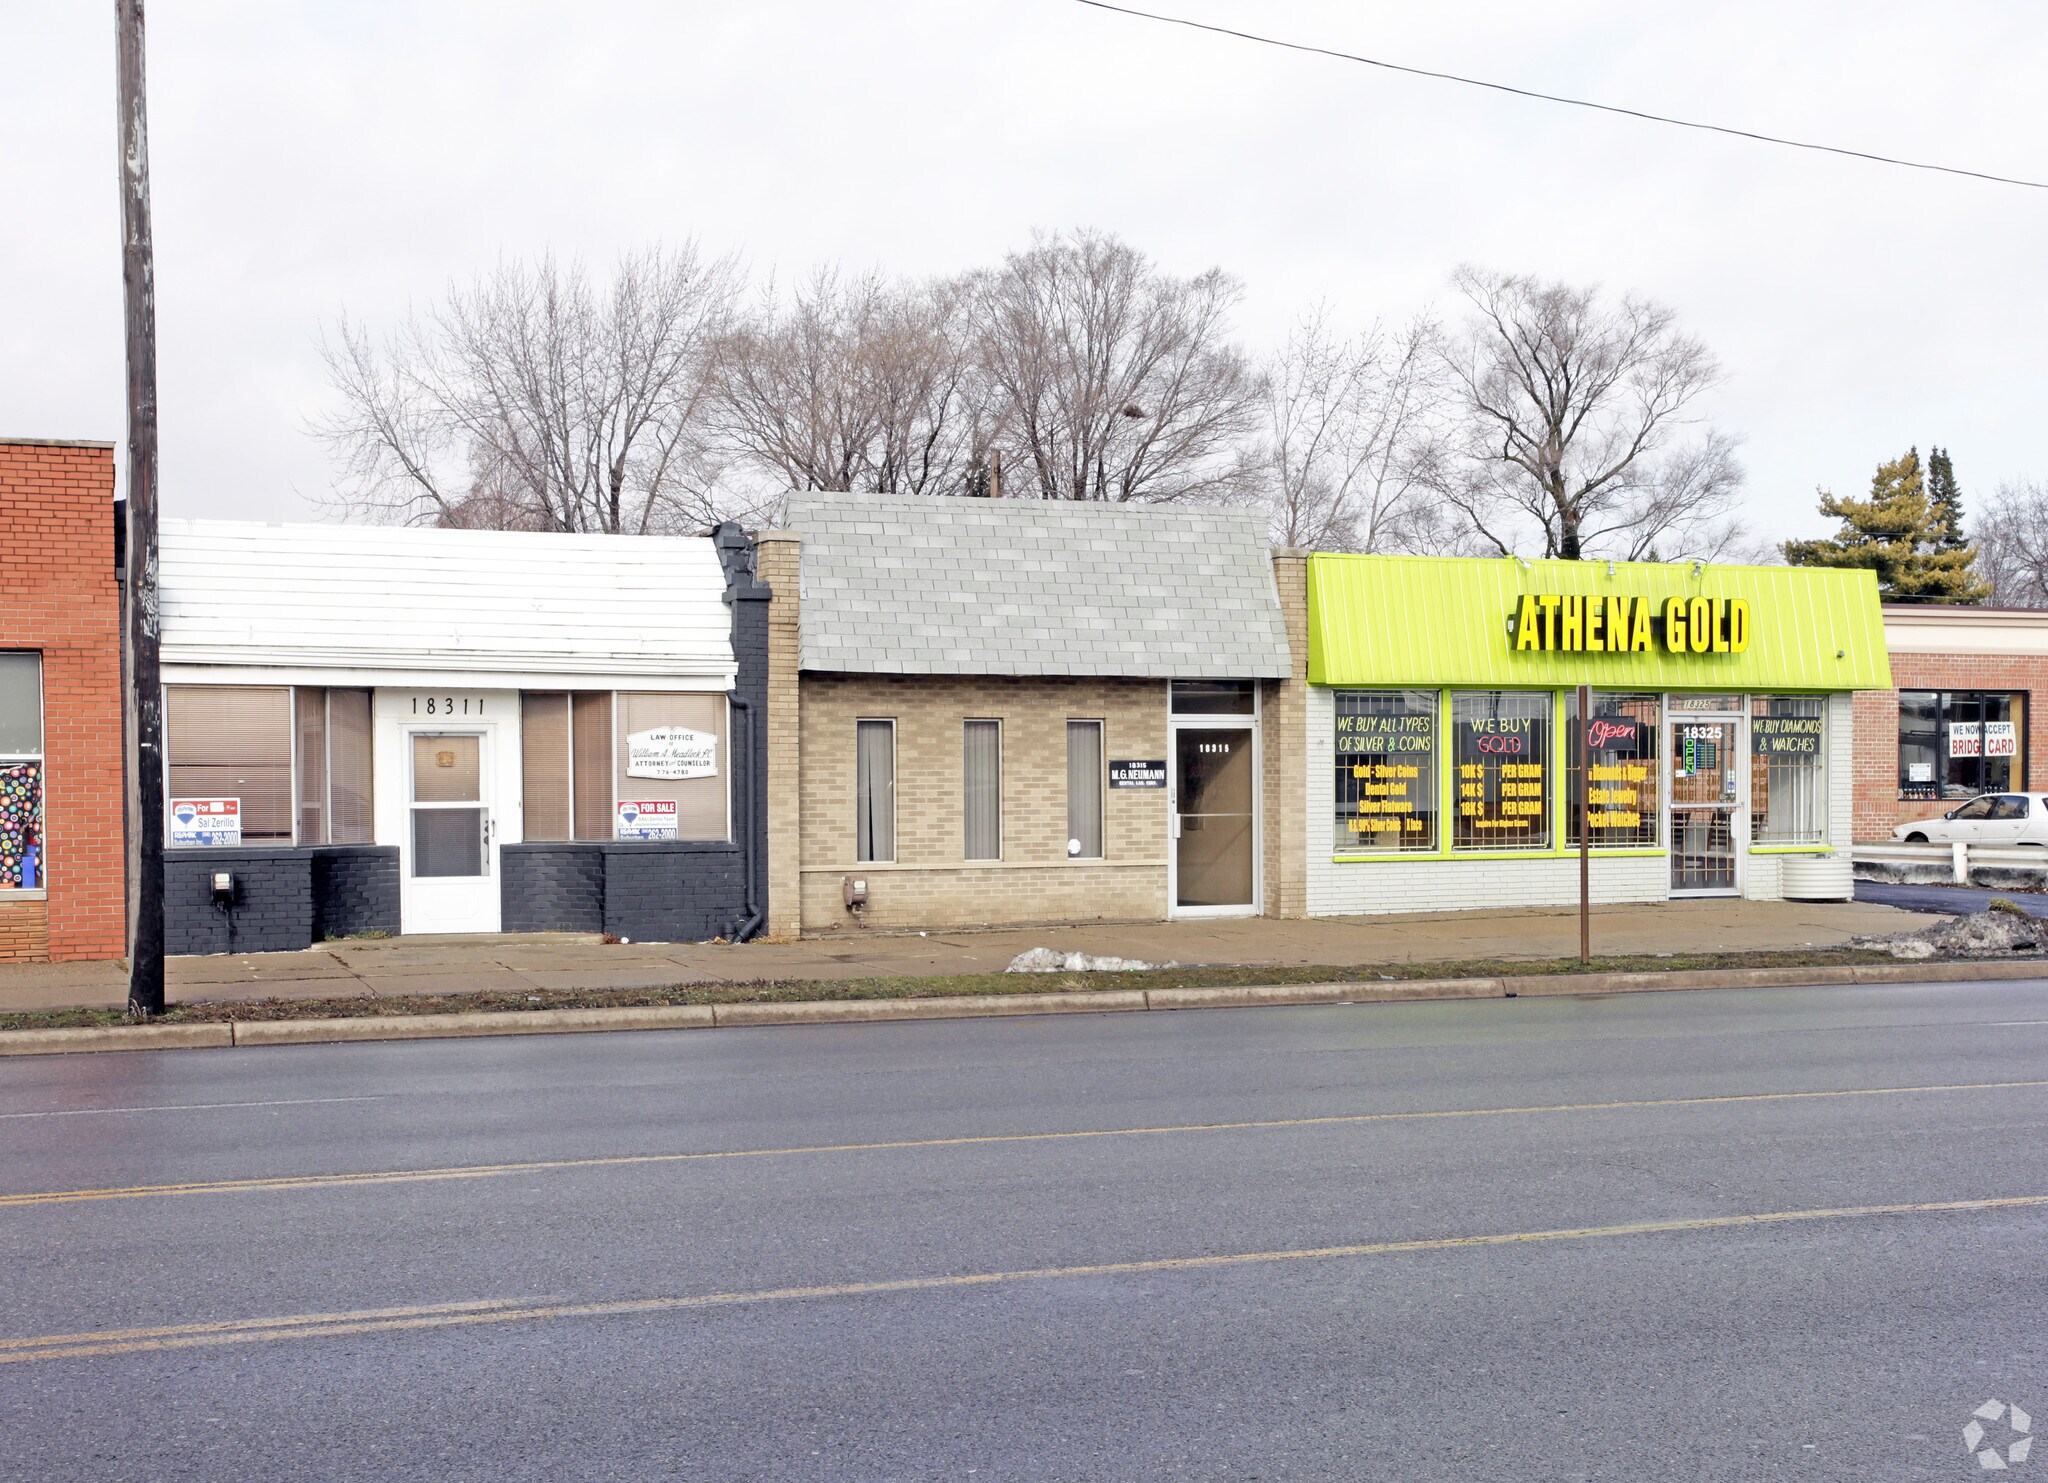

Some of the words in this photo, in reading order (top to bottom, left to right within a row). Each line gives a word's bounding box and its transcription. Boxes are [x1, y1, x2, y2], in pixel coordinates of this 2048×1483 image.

[1516, 594, 1652, 652] ATHENA
[1666, 596, 1750, 653] GOLD
[412, 697, 484, 715] 18311
[1684, 700, 1711, 708] 18325
[1337, 716, 1354, 732] WE
[1355, 716, 1378, 732] BUY
[1379, 718, 1397, 733] ALL
[1399, 716, 1430, 732] TYPES
[1471, 718, 1496, 733] WE
[1499, 718, 1531, 733] BUY
[1753, 719, 1764, 734] WE
[1764, 719, 1780, 734] BUY
[1780, 719, 1822, 734] DIAMONDS
[1953, 725, 1964, 735] WE
[1965, 724, 1981, 735] NOW
[1984, 724, 2011, 735] ACCEPT
[1588, 720, 1636, 748] Open
[1683, 727, 1723, 739] 18325
[1199, 744, 1229, 753] 18315
[1339, 736, 1353, 752] OF
[1354, 736, 1384, 752] SILVER
[1387, 736, 1396, 752] &
[1399, 735, 1431, 751] COINS
[1478, 736, 1522, 753] GOLD
[1759, 736, 1768, 752] &
[1771, 737, 1815, 752] WATCHES
[1952, 739, 1983, 754] BRIDG
[1988, 738, 2014, 754] CARD
[1685, 738, 1695, 774] OPEN
[1111, 769, 1128, 780] M.G.
[1128, 769, 1165, 780] NEUMANN
[1353, 764, 1371, 779] Gold
[1375, 764, 1397, 779] Silver
[1397, 764, 1418, 779] Coins
[1460, 764, 1476, 778] 10K
[1476, 763, 1484, 779] $
[1501, 764, 1517, 778] PER
[1517, 764, 1542, 778] GRAM
[1592, 764, 1622, 781] Diamonds
[1365, 782, 1389, 796] Dental
[1390, 782, 1407, 796] Gold
[1460, 783, 1476, 797] 14K
[1476, 782, 1484, 798] $
[1501, 783, 1517, 797] PER
[1517, 783, 1542, 797] GRAM
[1588, 787, 1610, 804] Estate
[1611, 787, 1637, 806] Jewelry
[197, 804, 209, 812] For
[640, 803, 656, 812] FOR
[656, 803, 675, 812] SALE
[1359, 799, 1381, 814] Silver
[1381, 799, 1413, 814] Flatware
[1460, 801, 1476, 816] 18K
[1476, 801, 1484, 816] $
[1501, 801, 1517, 816] PER
[1517, 801, 1542, 816] GRAM
[198, 817, 210, 828] Sal
[211, 817, 234, 828] Zerillo
[1610, 810, 1641, 828] Watches
[212, 831, 237, 845] 262-2000
[648, 829, 676, 840] 262-2000
